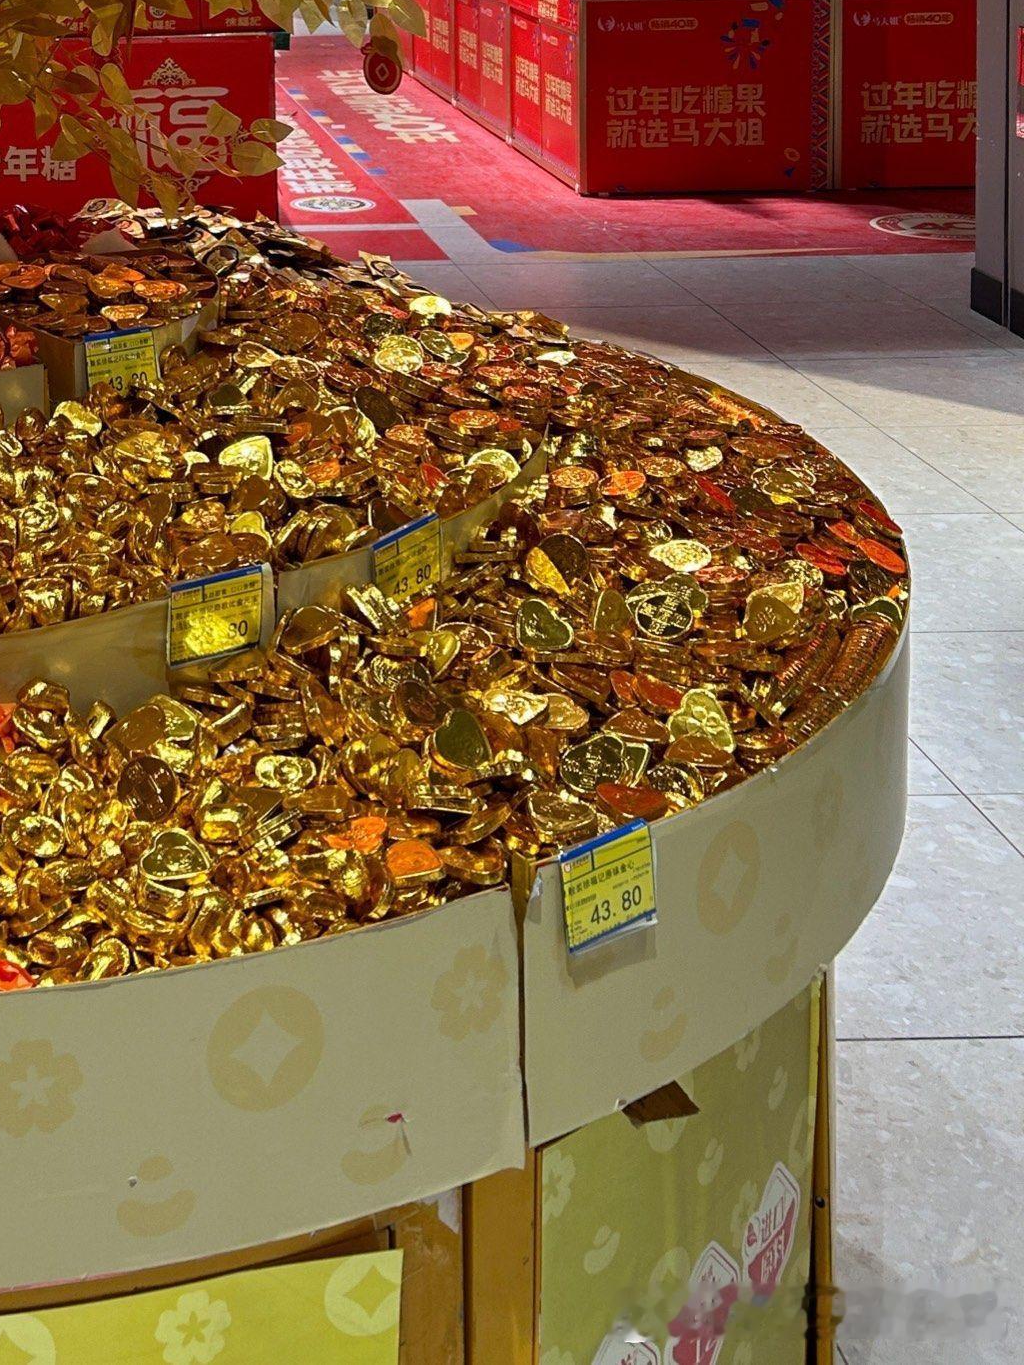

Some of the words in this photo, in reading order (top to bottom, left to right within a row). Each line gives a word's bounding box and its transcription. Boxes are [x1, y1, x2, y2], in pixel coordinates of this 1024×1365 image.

[605, 83, 767, 118] 过年吃糖果
[605, 118, 766, 148] 就选马大姐
[393, 564, 432, 597] 43.80
[590, 885, 642, 925] 43.80
